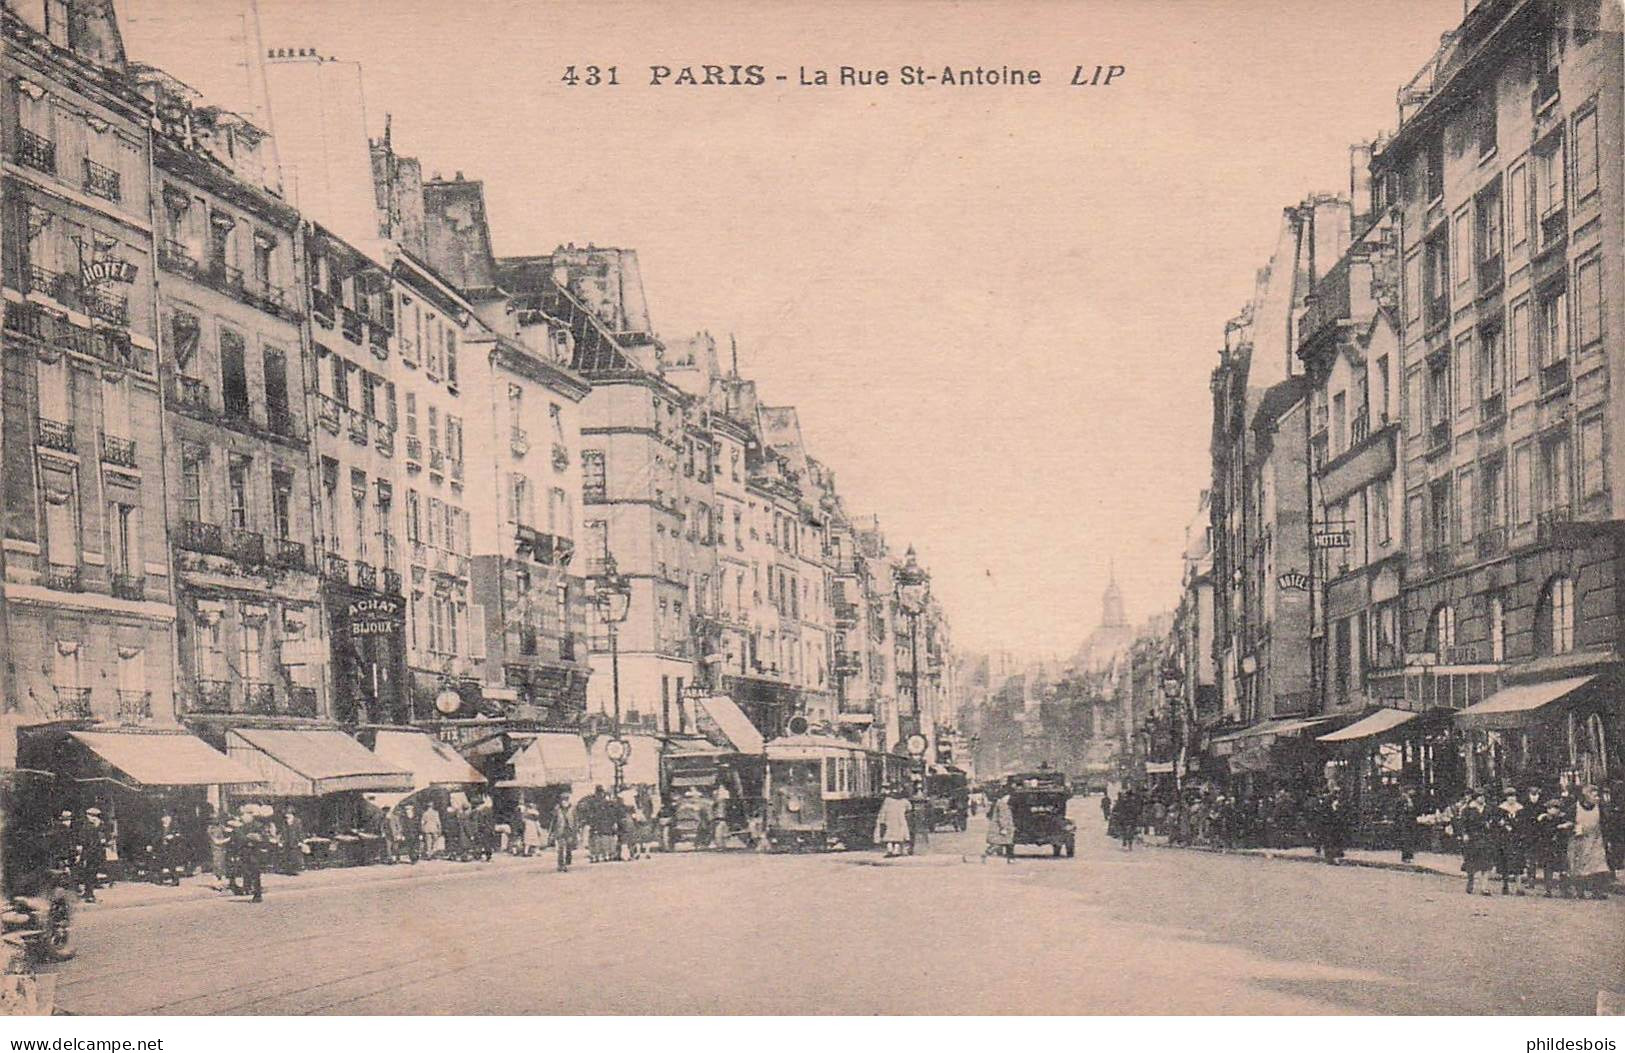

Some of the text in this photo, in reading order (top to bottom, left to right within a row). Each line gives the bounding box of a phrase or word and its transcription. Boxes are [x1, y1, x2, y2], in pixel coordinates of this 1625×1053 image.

[83, 263, 129, 283] HOTEL
[1314, 534, 1347, 547] HOTEL
[1279, 574, 1306, 589] HOTEL
[348, 599, 398, 615] ACHAT
[352, 621, 393, 635] BIJOUX
